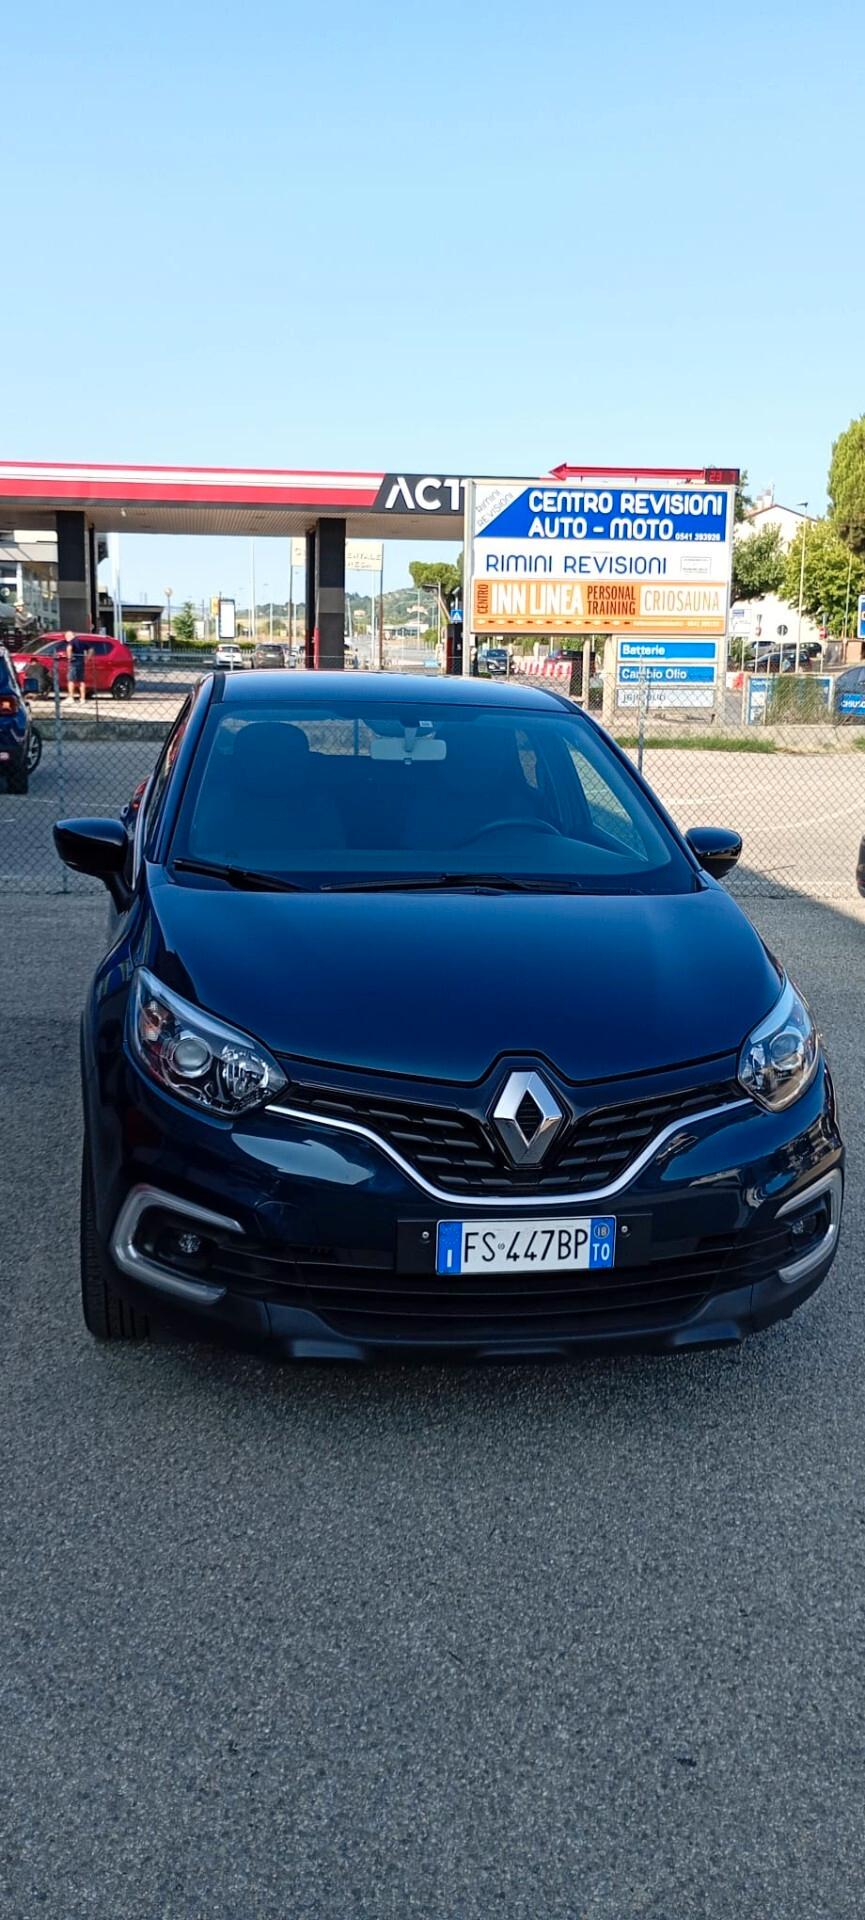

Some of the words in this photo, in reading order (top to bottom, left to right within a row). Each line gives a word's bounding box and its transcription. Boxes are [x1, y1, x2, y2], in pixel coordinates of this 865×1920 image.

[528, 491, 613, 514] CENTRO
[620, 493, 723, 516] REVISIONI
[528, 517, 588, 539] AUTO
[609, 518, 674, 540] MOTO
[486, 554, 552, 573] RIMINI
[563, 555, 667, 575] REVISIONI
[477, 584, 489, 614] CENTRO
[491, 583, 527, 616] INN
[530, 583, 584, 616] LINEA
[587, 585, 636, 600] PERSONAL
[644, 590, 720, 612] CRIOSAUNA
[587, 600, 636, 616] TRAINING
[622, 644, 666, 655] Batterie
[666, 668, 687, 680] Olio
[592, 1243, 611, 1261] TO
